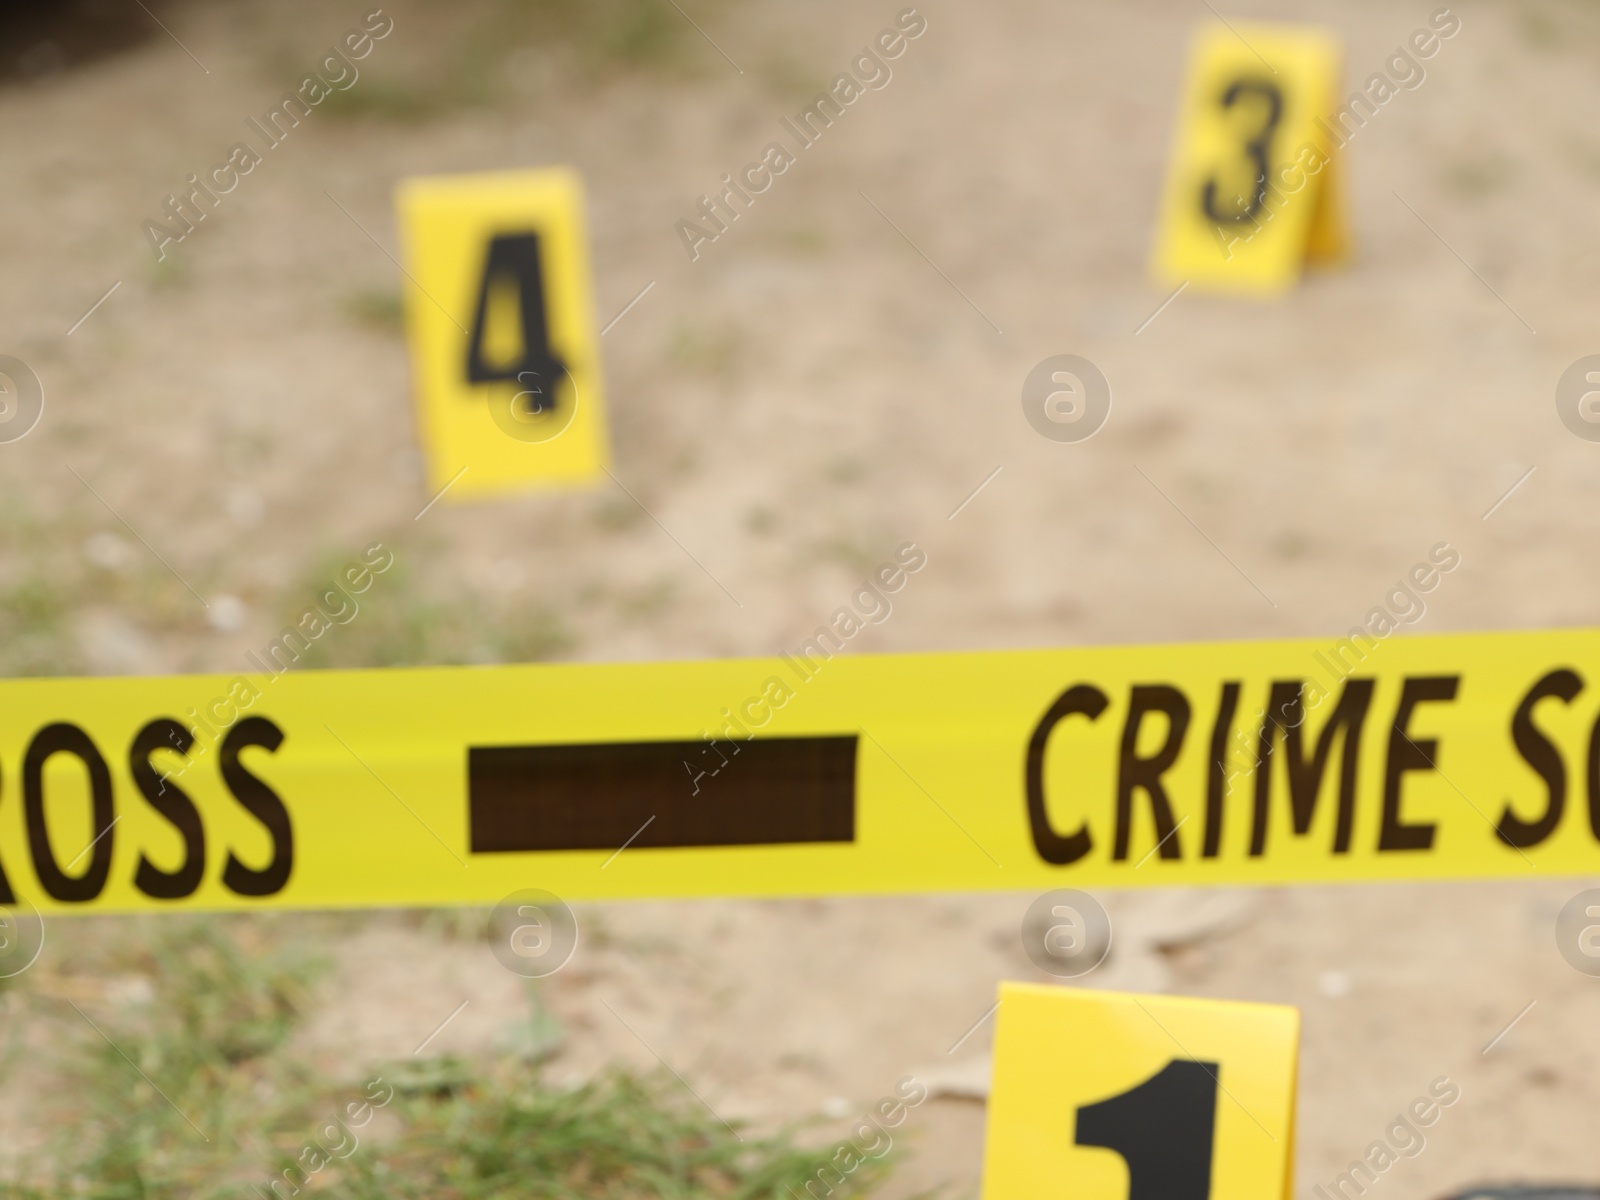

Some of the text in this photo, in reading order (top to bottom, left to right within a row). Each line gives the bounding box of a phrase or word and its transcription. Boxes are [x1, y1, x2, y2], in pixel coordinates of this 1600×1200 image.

[1200, 75, 1284, 230] 3
[463, 228, 574, 414] 4
[0, 666, 1600, 904] OSS CRIME S
